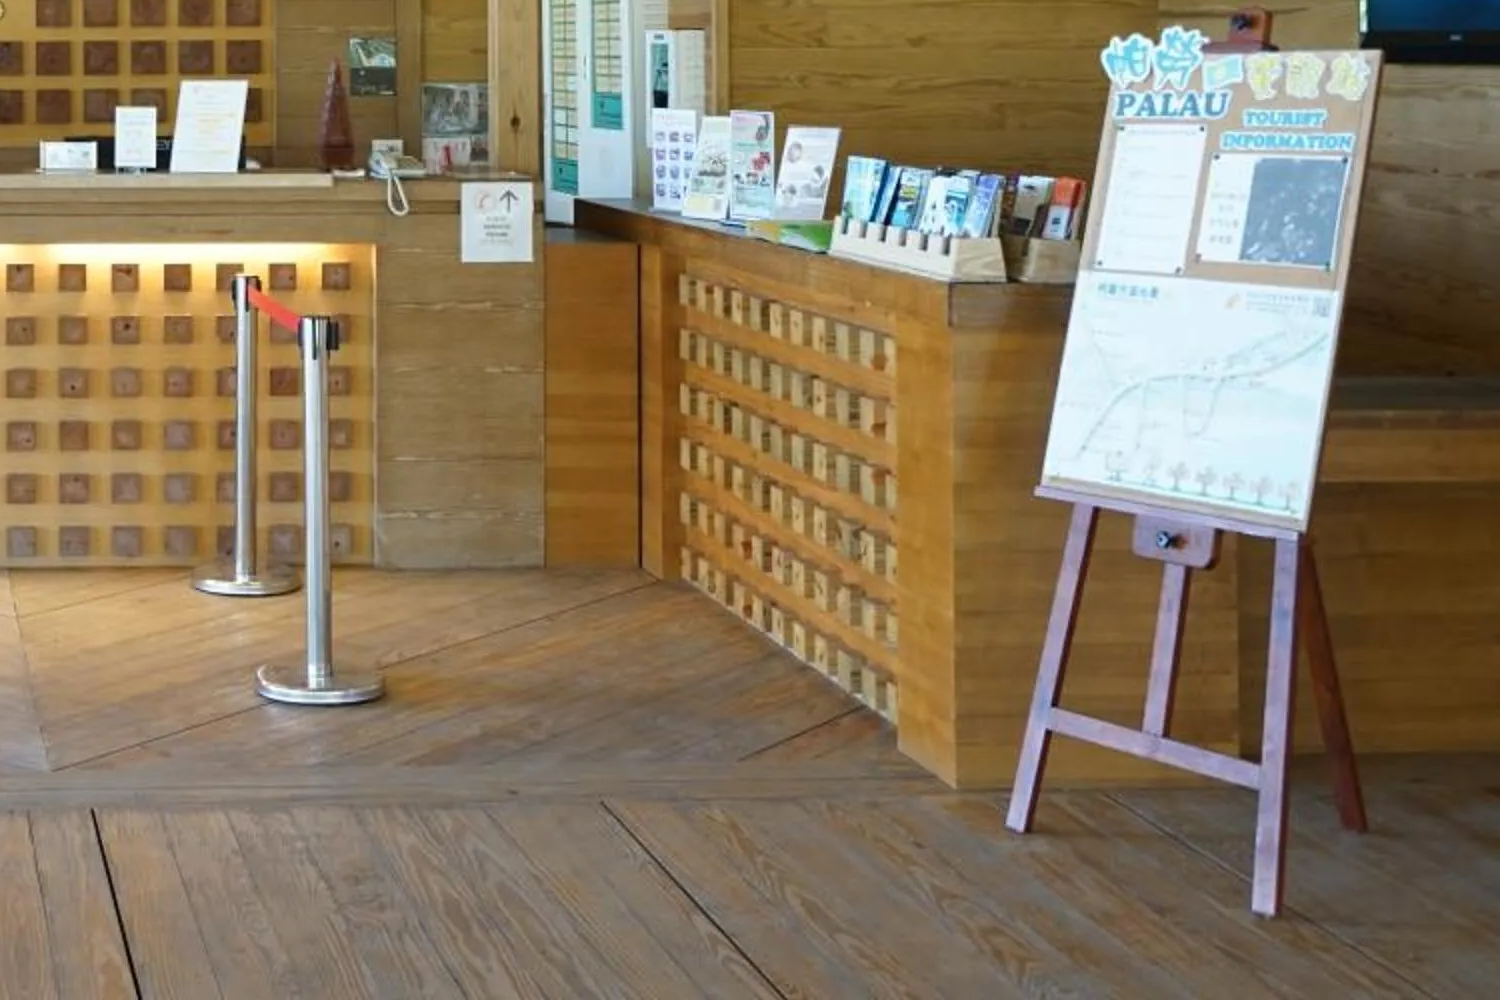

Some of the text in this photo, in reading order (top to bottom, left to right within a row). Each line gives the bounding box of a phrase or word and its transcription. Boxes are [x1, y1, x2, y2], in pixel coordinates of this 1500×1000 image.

[1115, 91, 1230, 118] PALAU
[1245, 111, 1326, 126] TOURIST
[1222, 133, 1354, 149] INFORMATION
